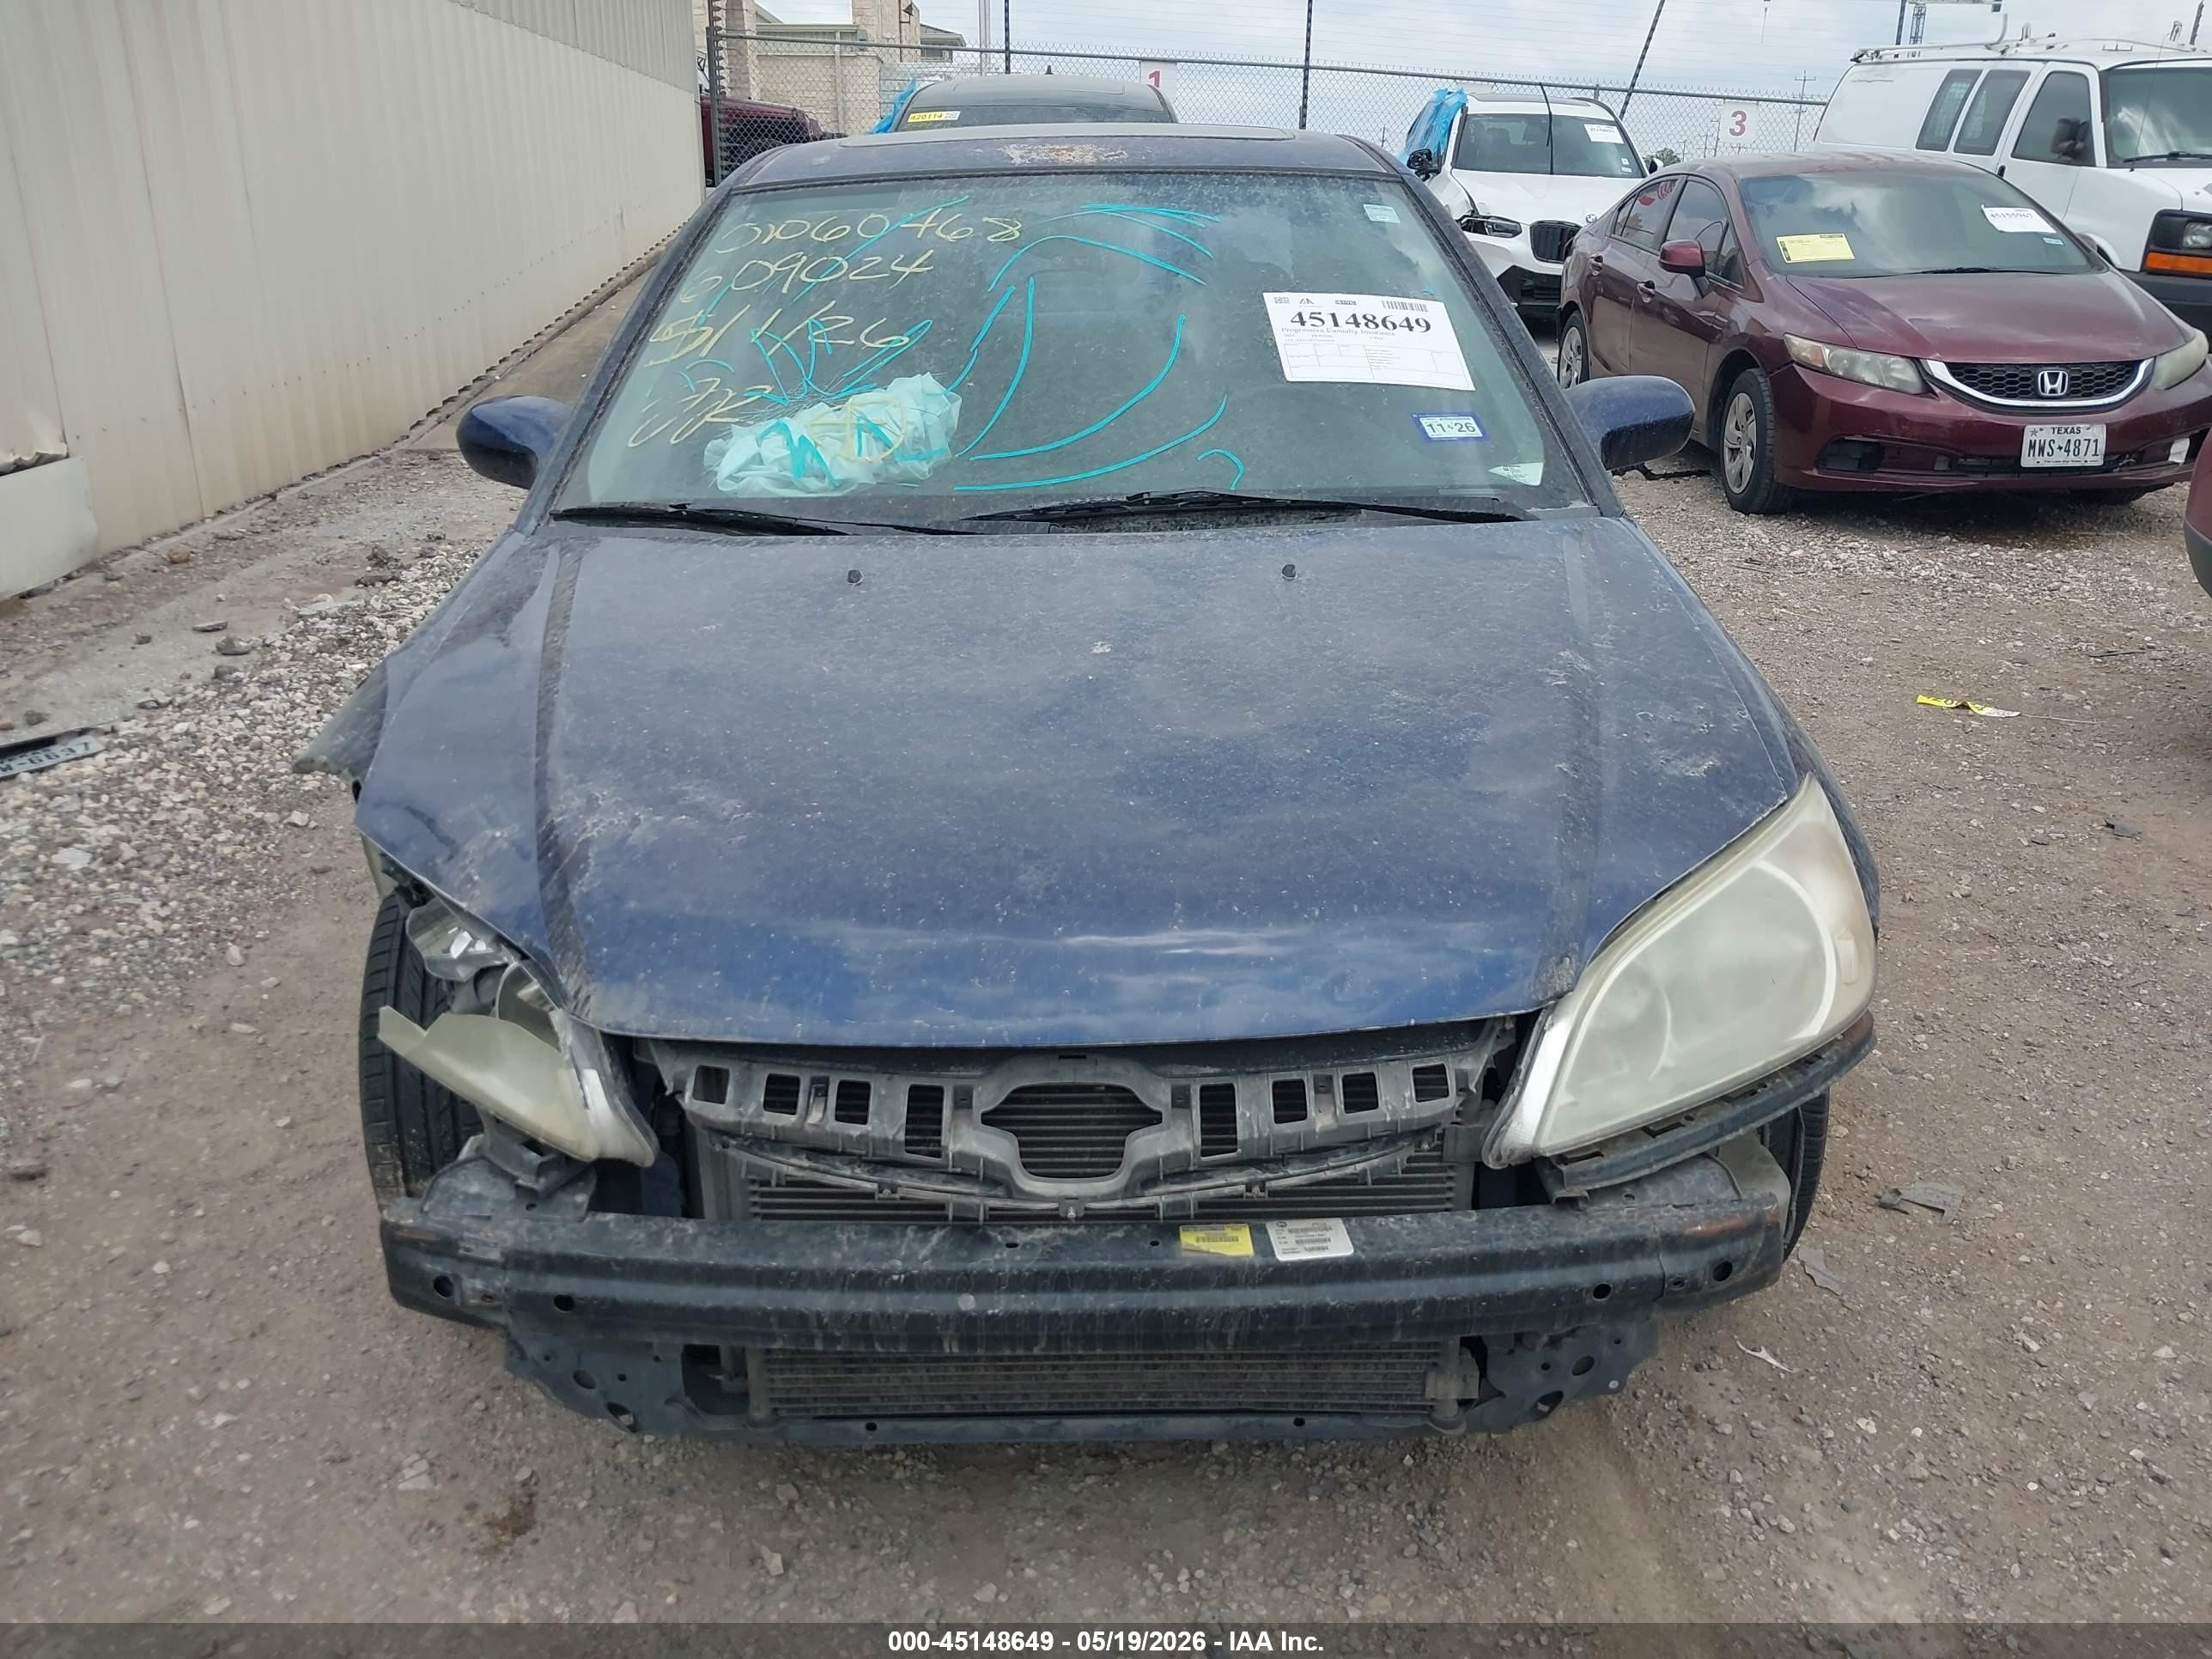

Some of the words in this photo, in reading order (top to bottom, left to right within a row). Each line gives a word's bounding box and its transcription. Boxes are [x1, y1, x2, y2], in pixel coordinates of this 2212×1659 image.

[1729, 110, 1747, 137] 3
[1290, 311, 1431, 333] 45148649
[2051, 426, 2081, 434] TEXAS
